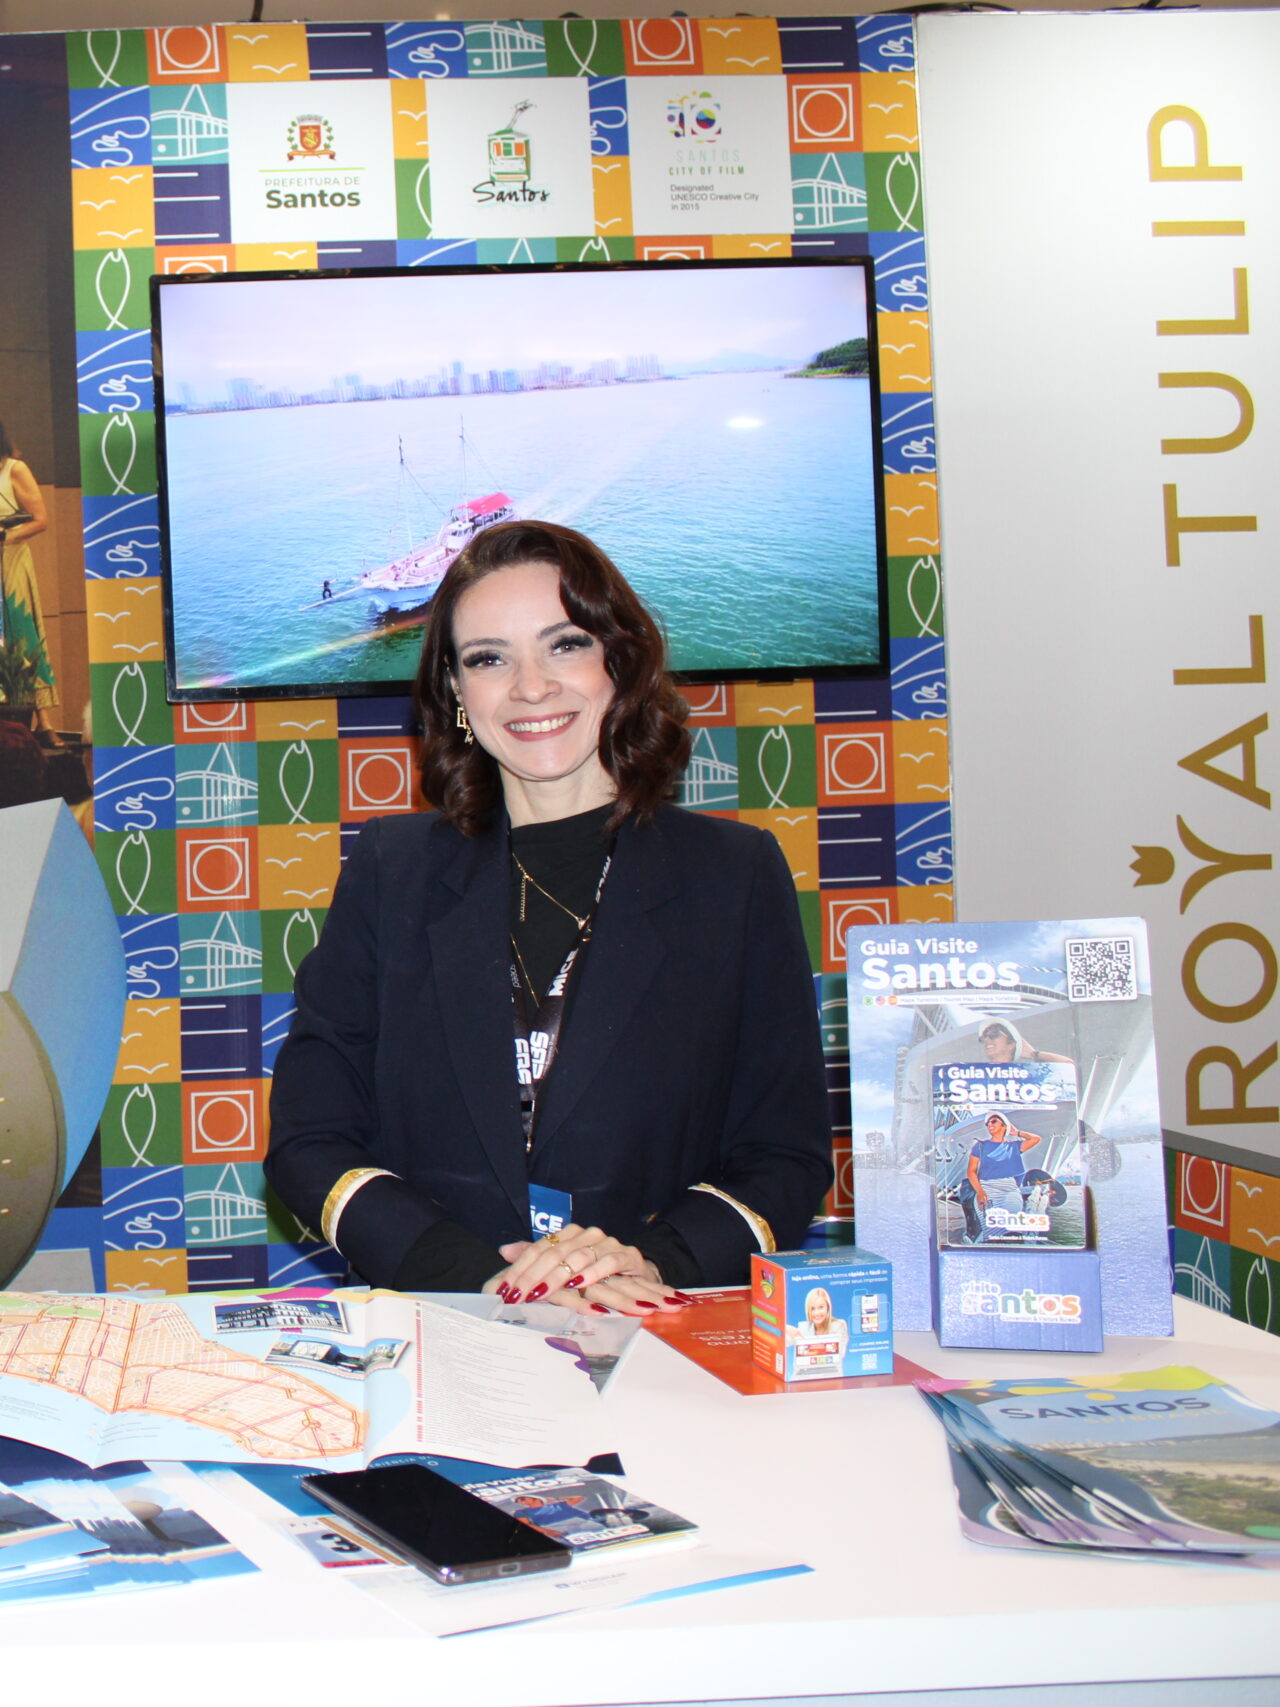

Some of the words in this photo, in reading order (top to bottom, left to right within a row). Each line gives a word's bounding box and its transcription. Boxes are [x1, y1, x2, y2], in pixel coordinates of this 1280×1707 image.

[676, 149, 740, 163] SANTOS
[669, 167, 693, 176] CITY
[700, 166, 712, 175] OF
[719, 166, 745, 174] FILM
[265, 177, 340, 187] PREFEITURA
[344, 176, 360, 185] DE
[670, 184, 714, 193] Designated
[266, 189, 361, 209] Santos
[472, 180, 550, 203] Santos
[671, 193, 708, 201] UNESCO
[710, 193, 741, 201] Creative
[744, 192, 759, 202] City
[680, 203, 700, 211] 2015
[1146, 104, 1258, 567] TULIP
[1172, 614, 1280, 1127] ROYAL
[860, 939, 910, 956] Guia
[915, 937, 979, 955] Visite
[862, 957, 1020, 990] Santos
[948, 1066, 985, 1080] Guia
[985, 1066, 1029, 1079] Visite
[949, 1080, 1057, 1102] Santos
[988, 1212, 1048, 1226] santos
[962, 1282, 1000, 1294] visite
[962, 1290, 1080, 1315] santos
[999, 1397, 1211, 1420] SANTOS
[470, 1477, 580, 1498] antos
[322, 1533, 363, 1553] 3
